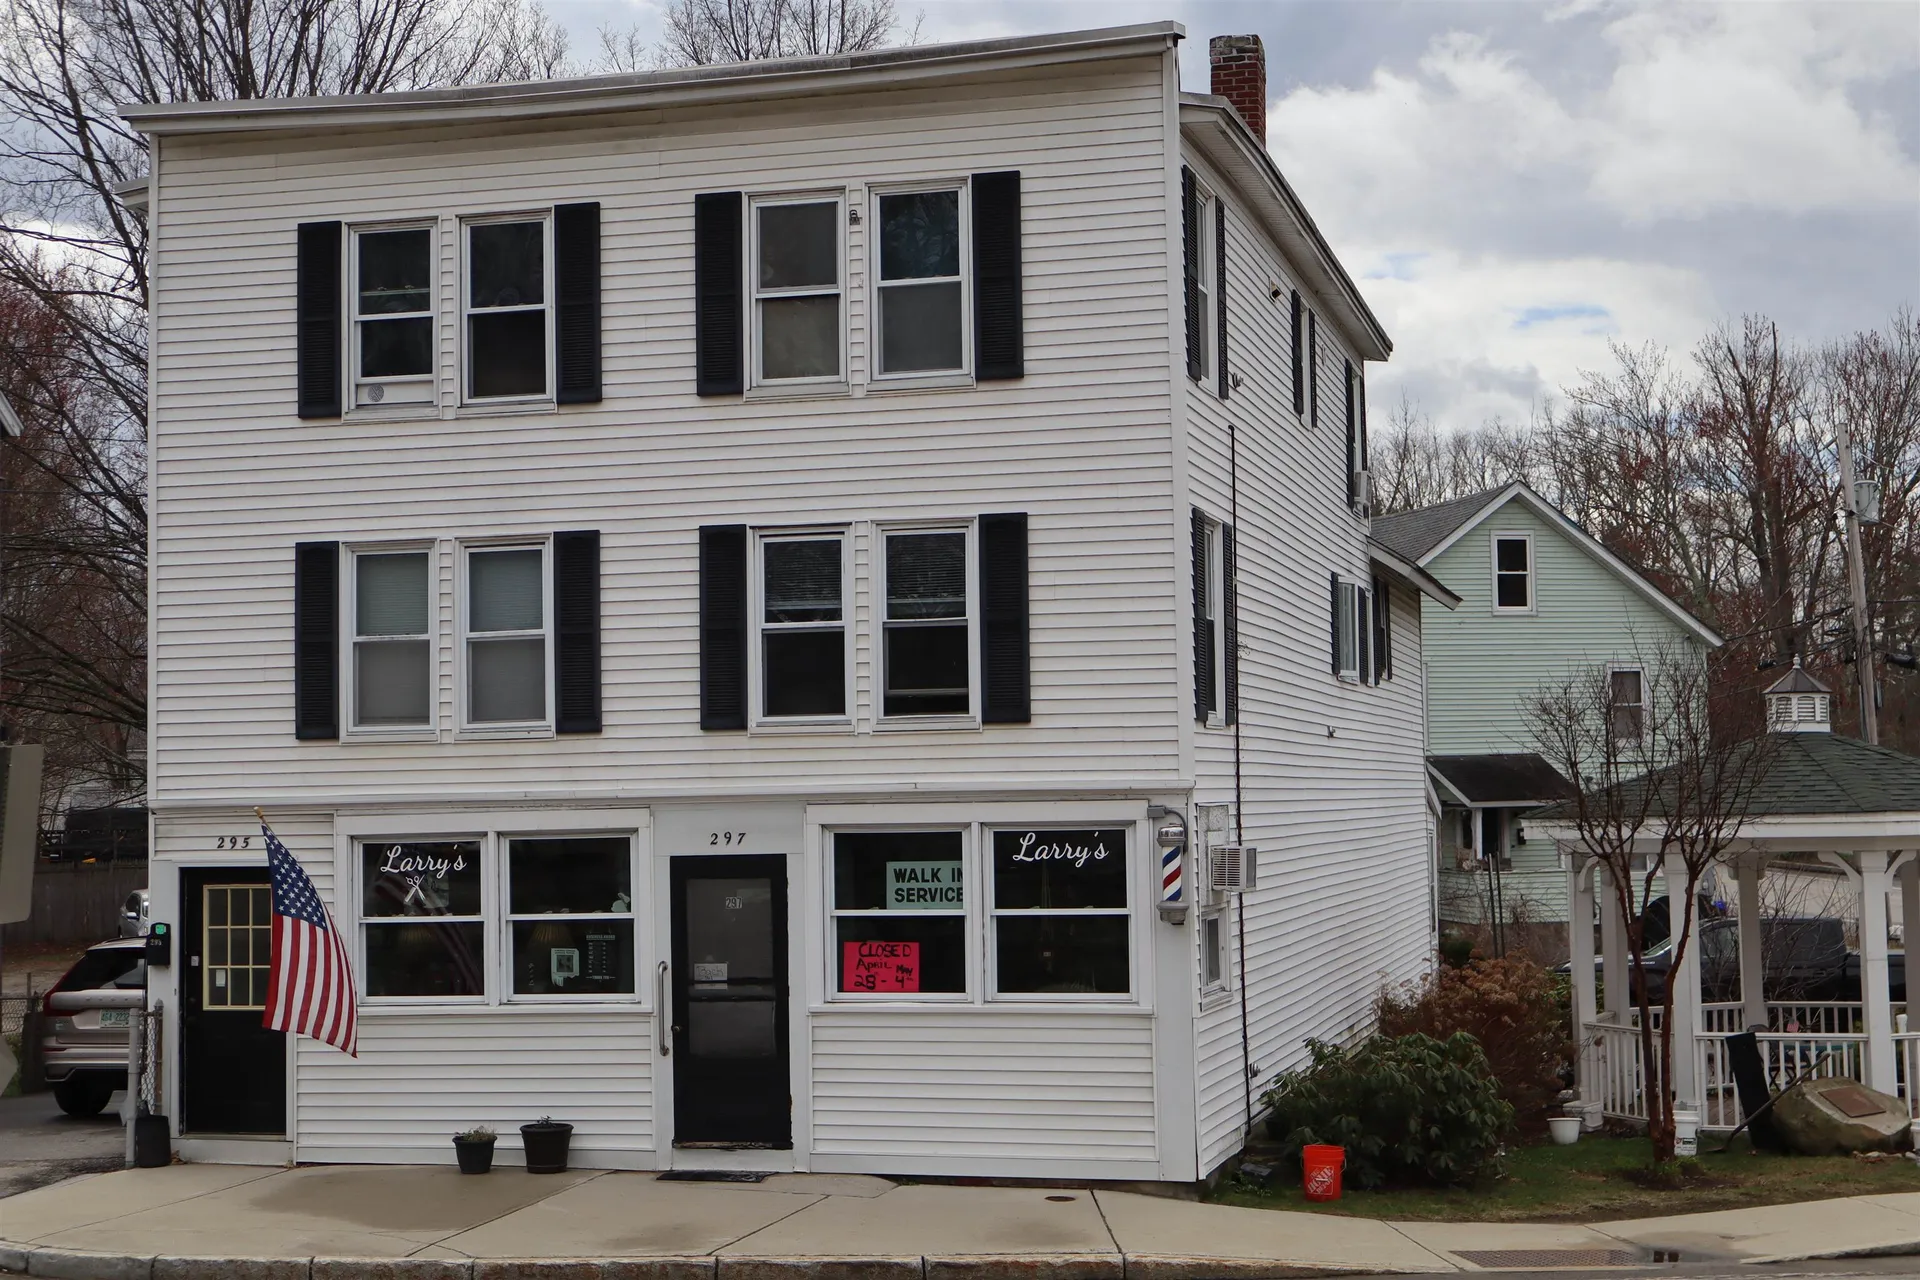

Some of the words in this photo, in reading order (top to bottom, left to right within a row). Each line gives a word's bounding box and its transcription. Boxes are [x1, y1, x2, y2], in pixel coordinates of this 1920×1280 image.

[217, 836, 250, 849] 295
[710, 831, 746, 846] 297
[1012, 831, 1109, 868] Larry's
[380, 844, 467, 879] Larry's
[893, 867, 942, 883] WALK
[726, 897, 743, 909] 297
[894, 887, 963, 903] SERVICE
[858, 942, 911, 958] CLOSED
